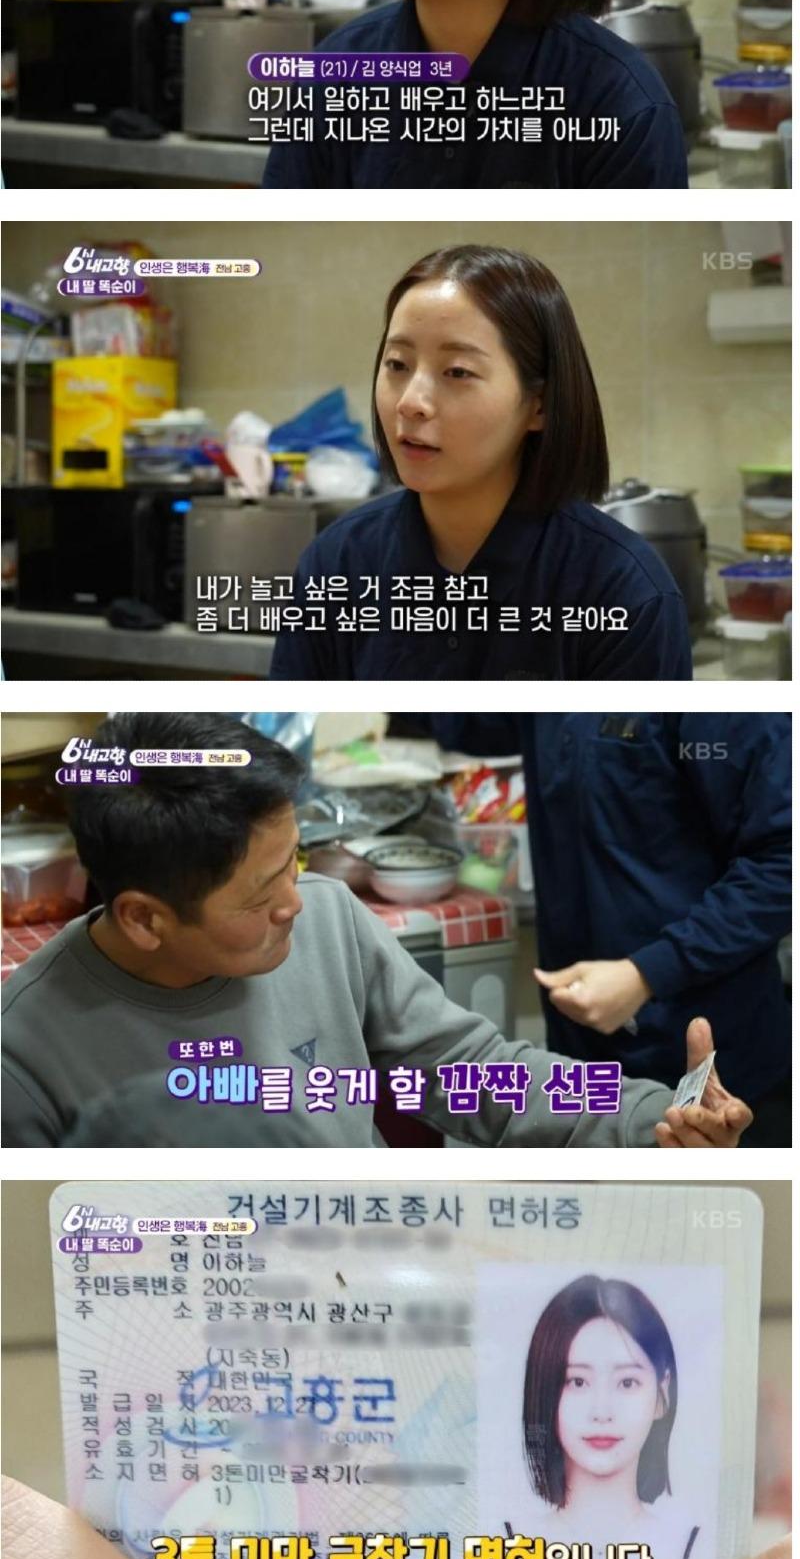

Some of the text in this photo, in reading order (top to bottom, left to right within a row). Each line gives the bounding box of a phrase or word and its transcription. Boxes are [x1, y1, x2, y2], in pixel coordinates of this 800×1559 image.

[228, 1195, 582, 1227] 건설기계조종사 면허증
[202, 1252, 267, 1272] 이하늘
[75, 1276, 188, 1296] 주민등록번호
[206, 1301, 394, 1323] 광주광역시 광산구
[335, 1431, 394, 1443] COUNTY
